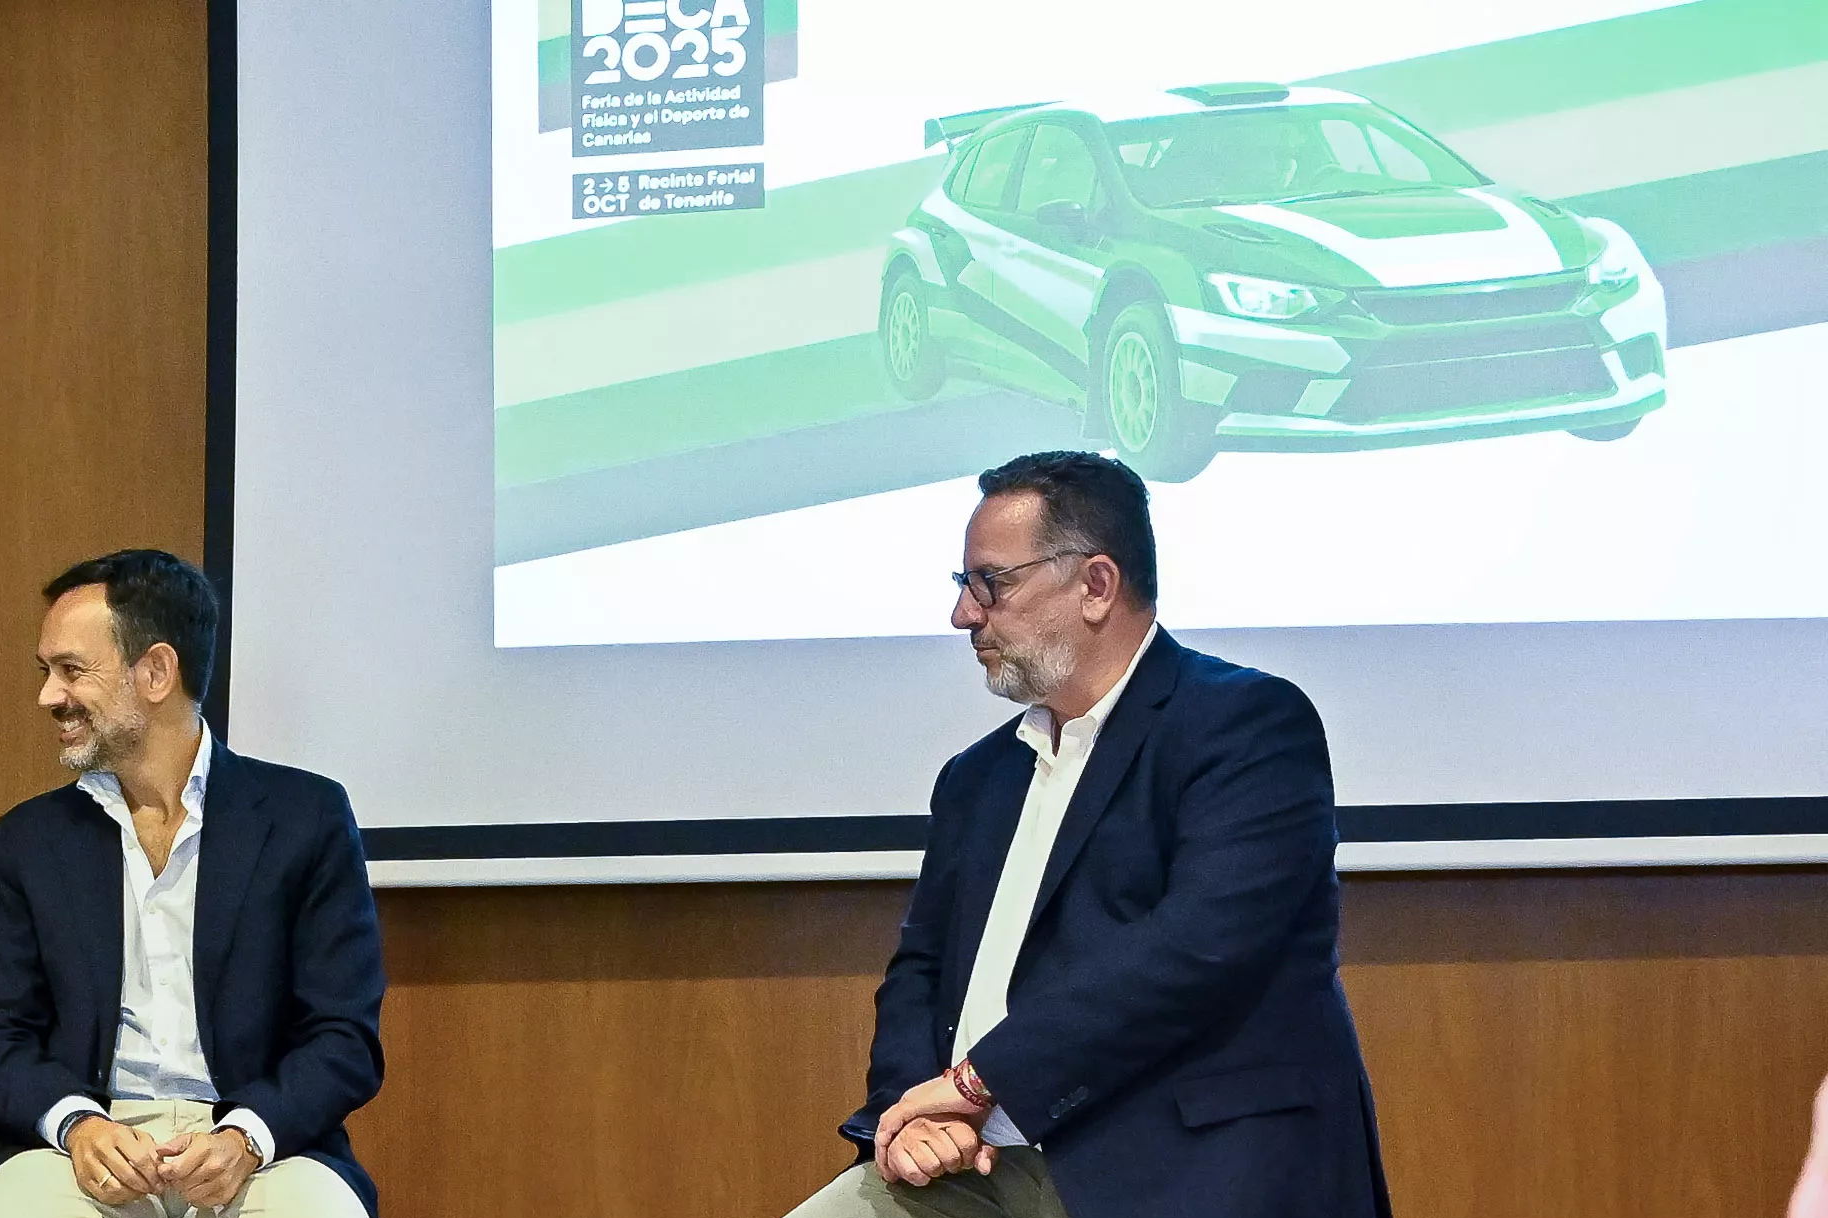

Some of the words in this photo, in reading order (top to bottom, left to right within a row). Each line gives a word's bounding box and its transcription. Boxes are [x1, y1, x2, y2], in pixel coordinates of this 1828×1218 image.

[583, 26, 748, 84] 2025
[582, 95, 620, 109] Feria
[624, 92, 644, 107] de
[647, 90, 661, 105] la
[664, 85, 740, 103] Actividad
[631, 113, 640, 127] y
[644, 110, 658, 124] el
[662, 108, 725, 125] Deporte
[728, 104, 749, 119] de
[582, 131, 651, 147] Canarias
[583, 178, 595, 194] 2
[618, 176, 630, 192] 5
[639, 174, 704, 190] Recinto
[708, 168, 755, 185] Ferial
[583, 194, 629, 214] OCT
[639, 196, 661, 211] de
[664, 190, 734, 208] Tenerife
